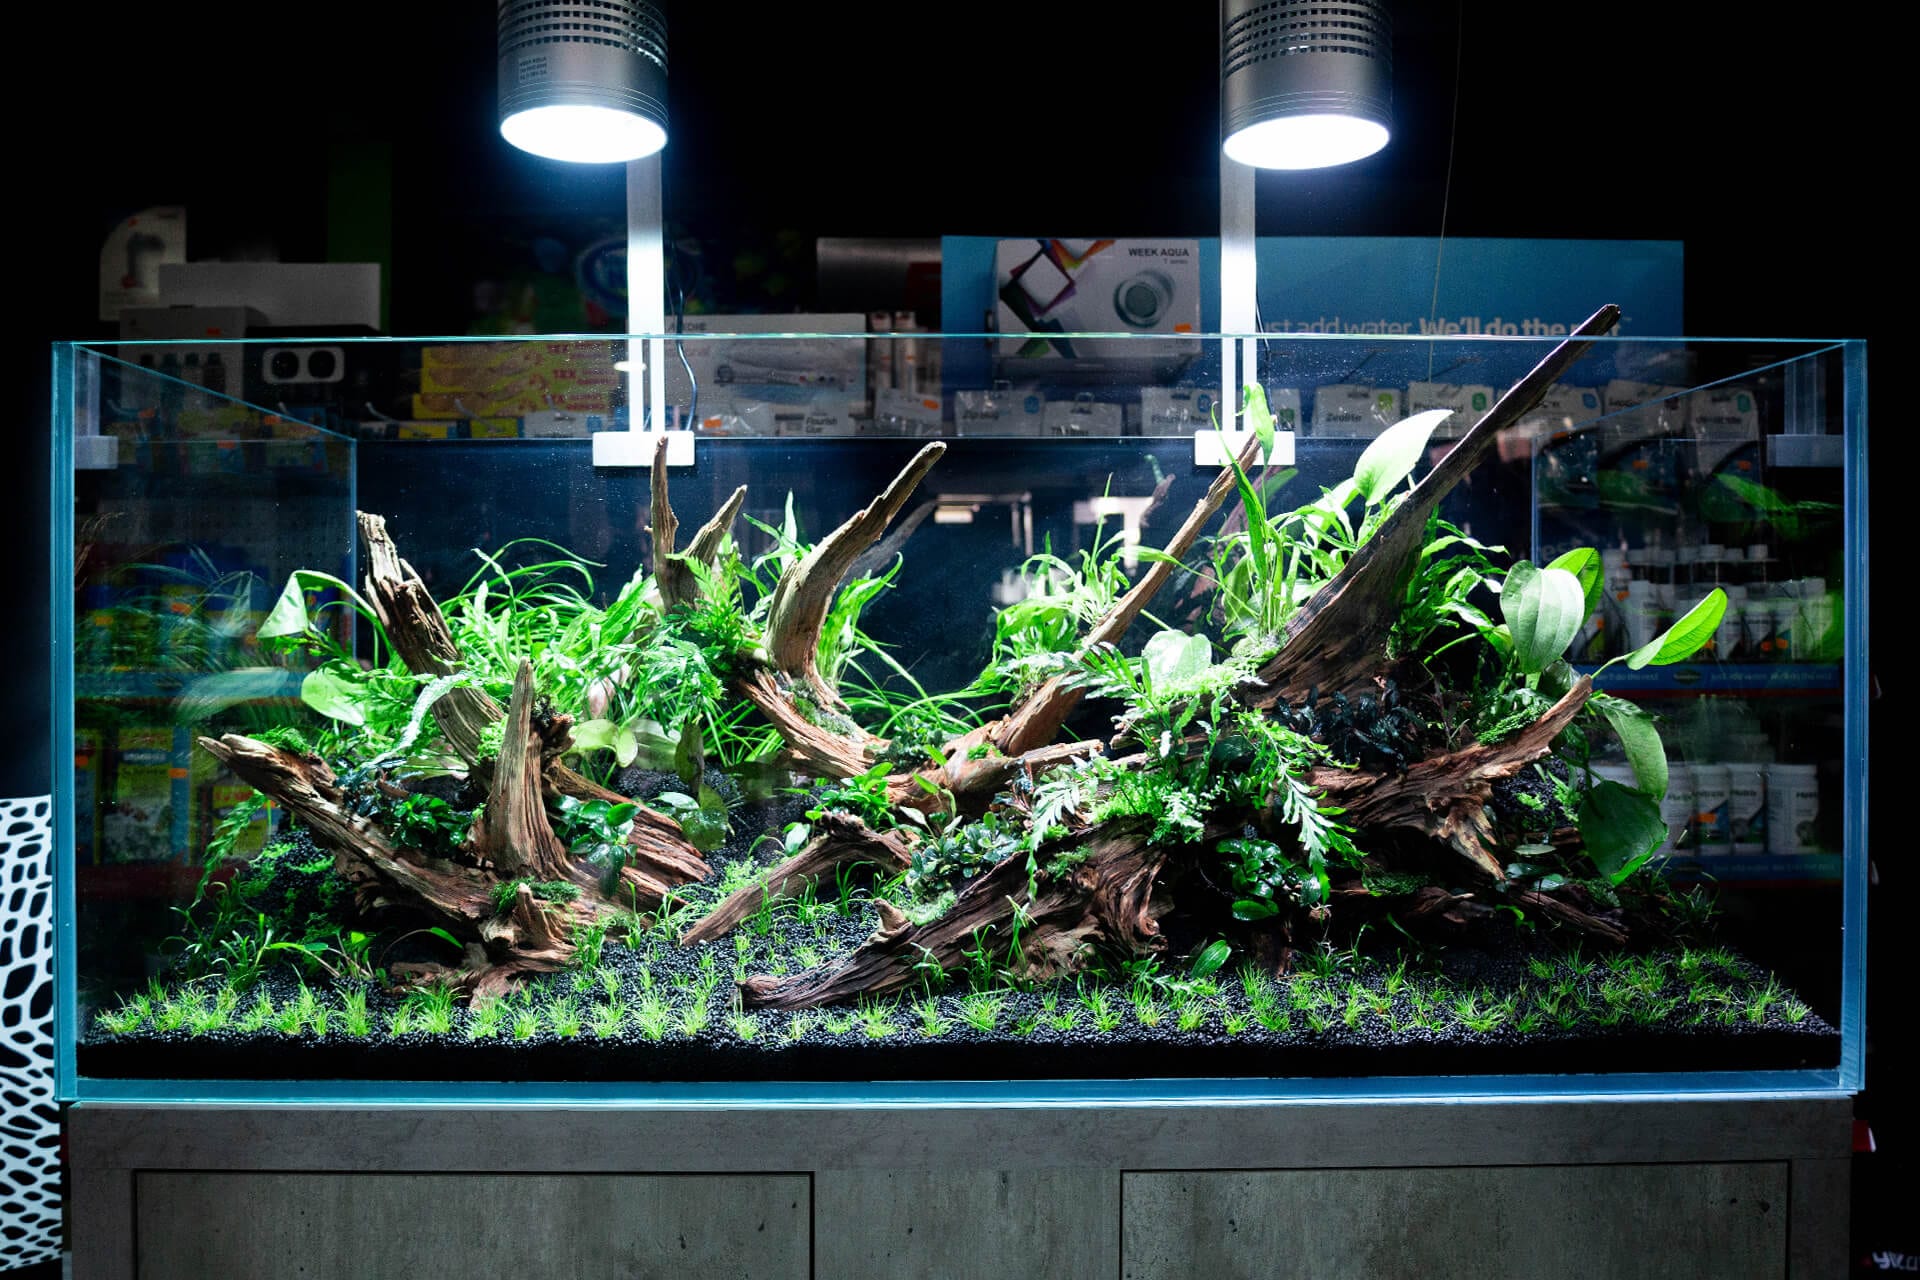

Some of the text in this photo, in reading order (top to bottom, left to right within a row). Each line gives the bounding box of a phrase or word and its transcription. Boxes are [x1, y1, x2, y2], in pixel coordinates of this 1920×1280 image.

[1128, 247, 1189, 257] WEEK AQUA
[1298, 316, 1340, 334] add
[1419, 316, 1480, 337] We'll
[1485, 316, 1518, 337] do
[1521, 317, 1567, 337] the
